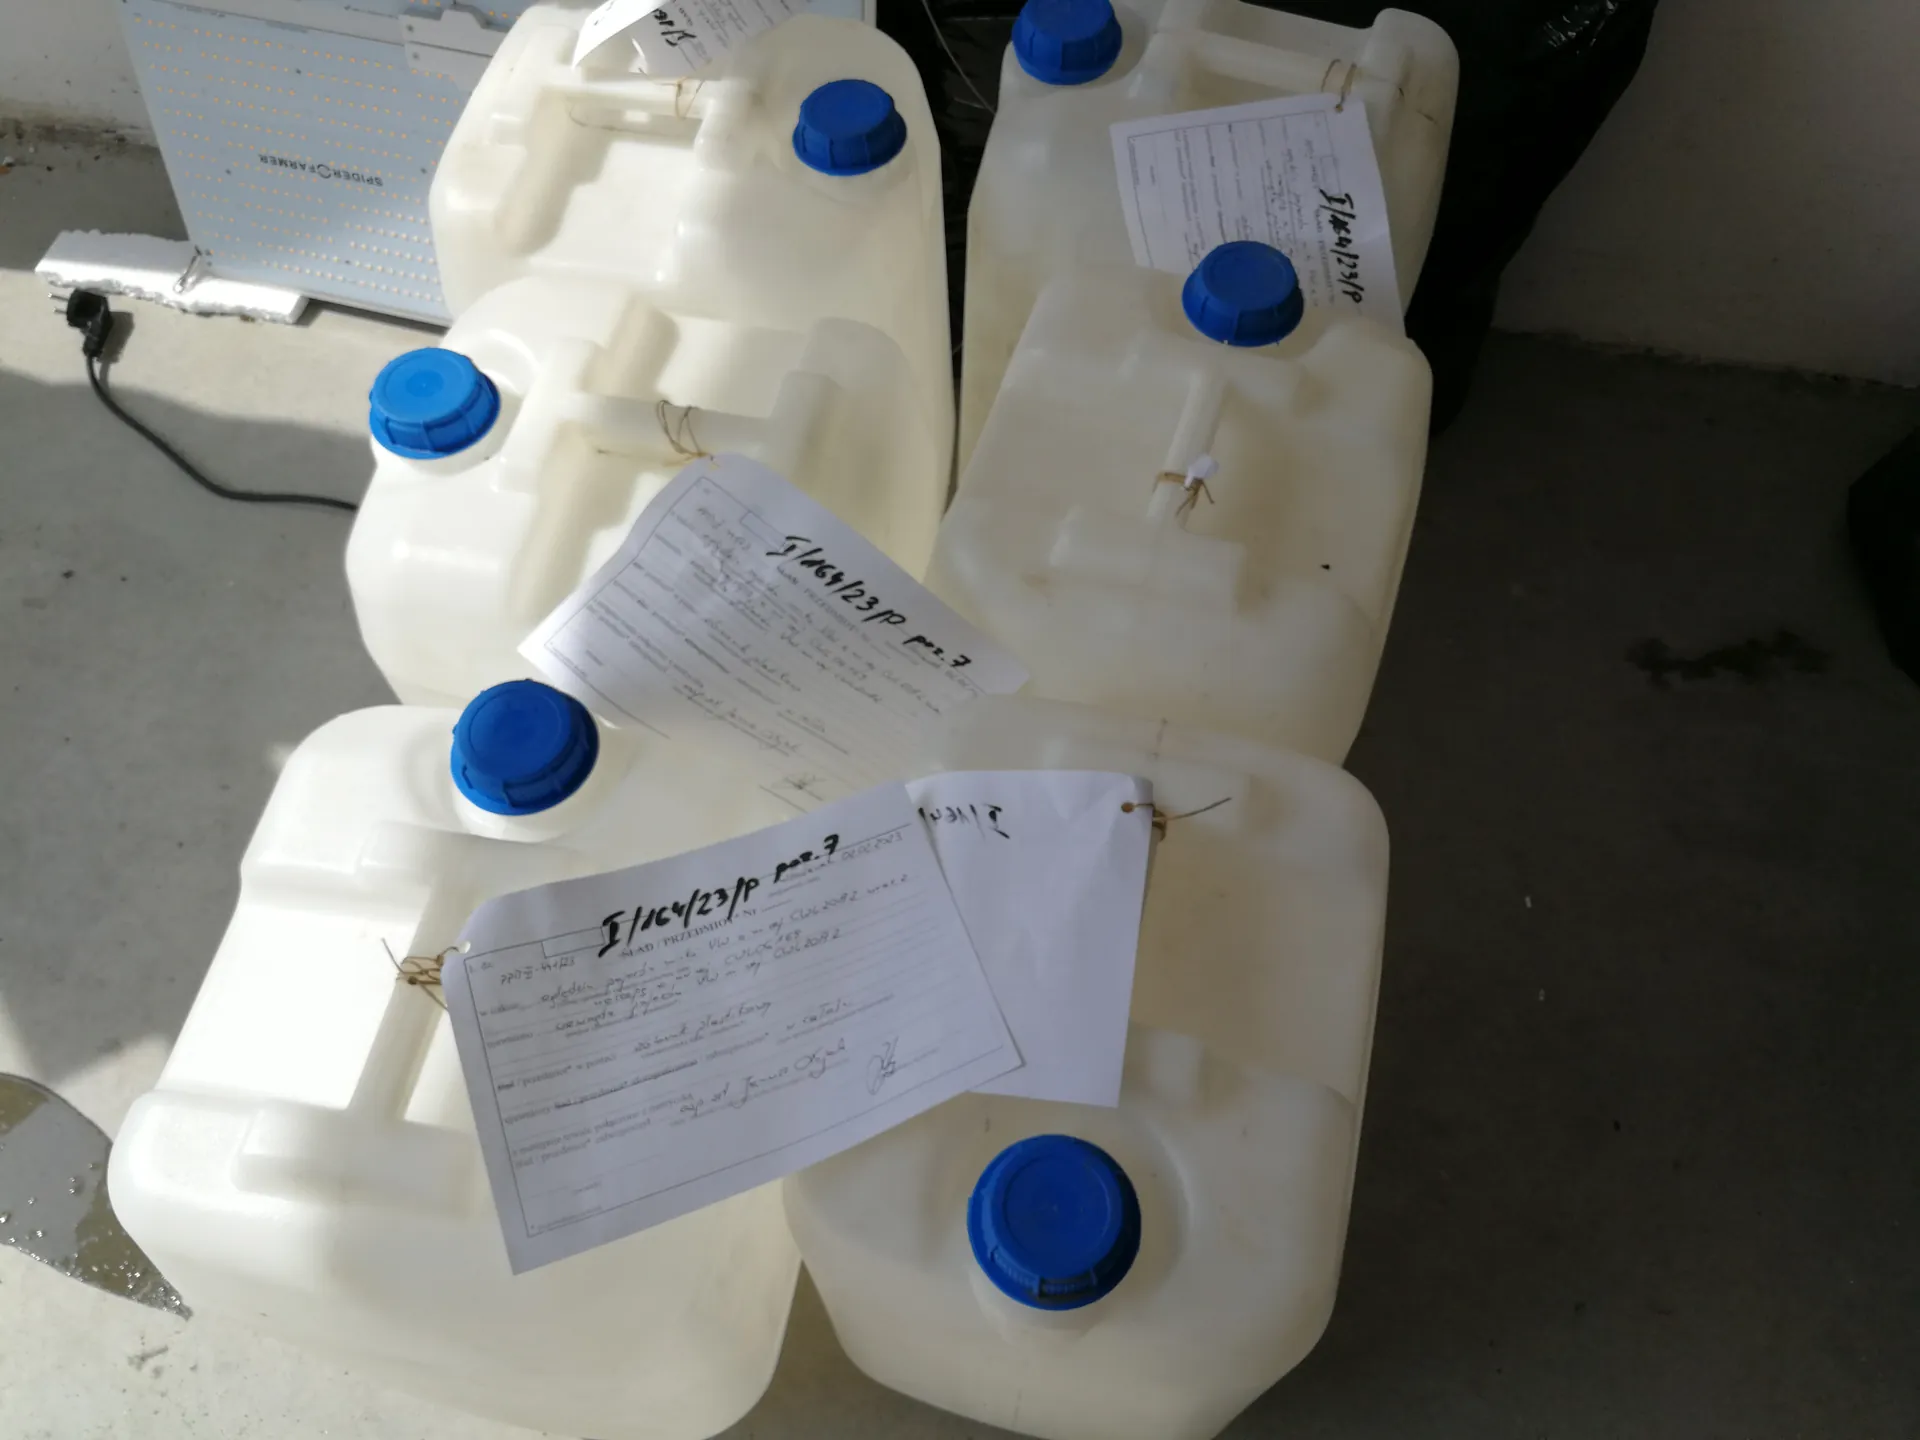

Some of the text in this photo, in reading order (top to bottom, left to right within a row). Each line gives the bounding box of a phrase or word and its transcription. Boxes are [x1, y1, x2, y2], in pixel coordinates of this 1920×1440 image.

[257, 153, 384, 187] SPIDER FARMER
[950, 653, 973, 668] 7
[823, 833, 841, 855] 7
